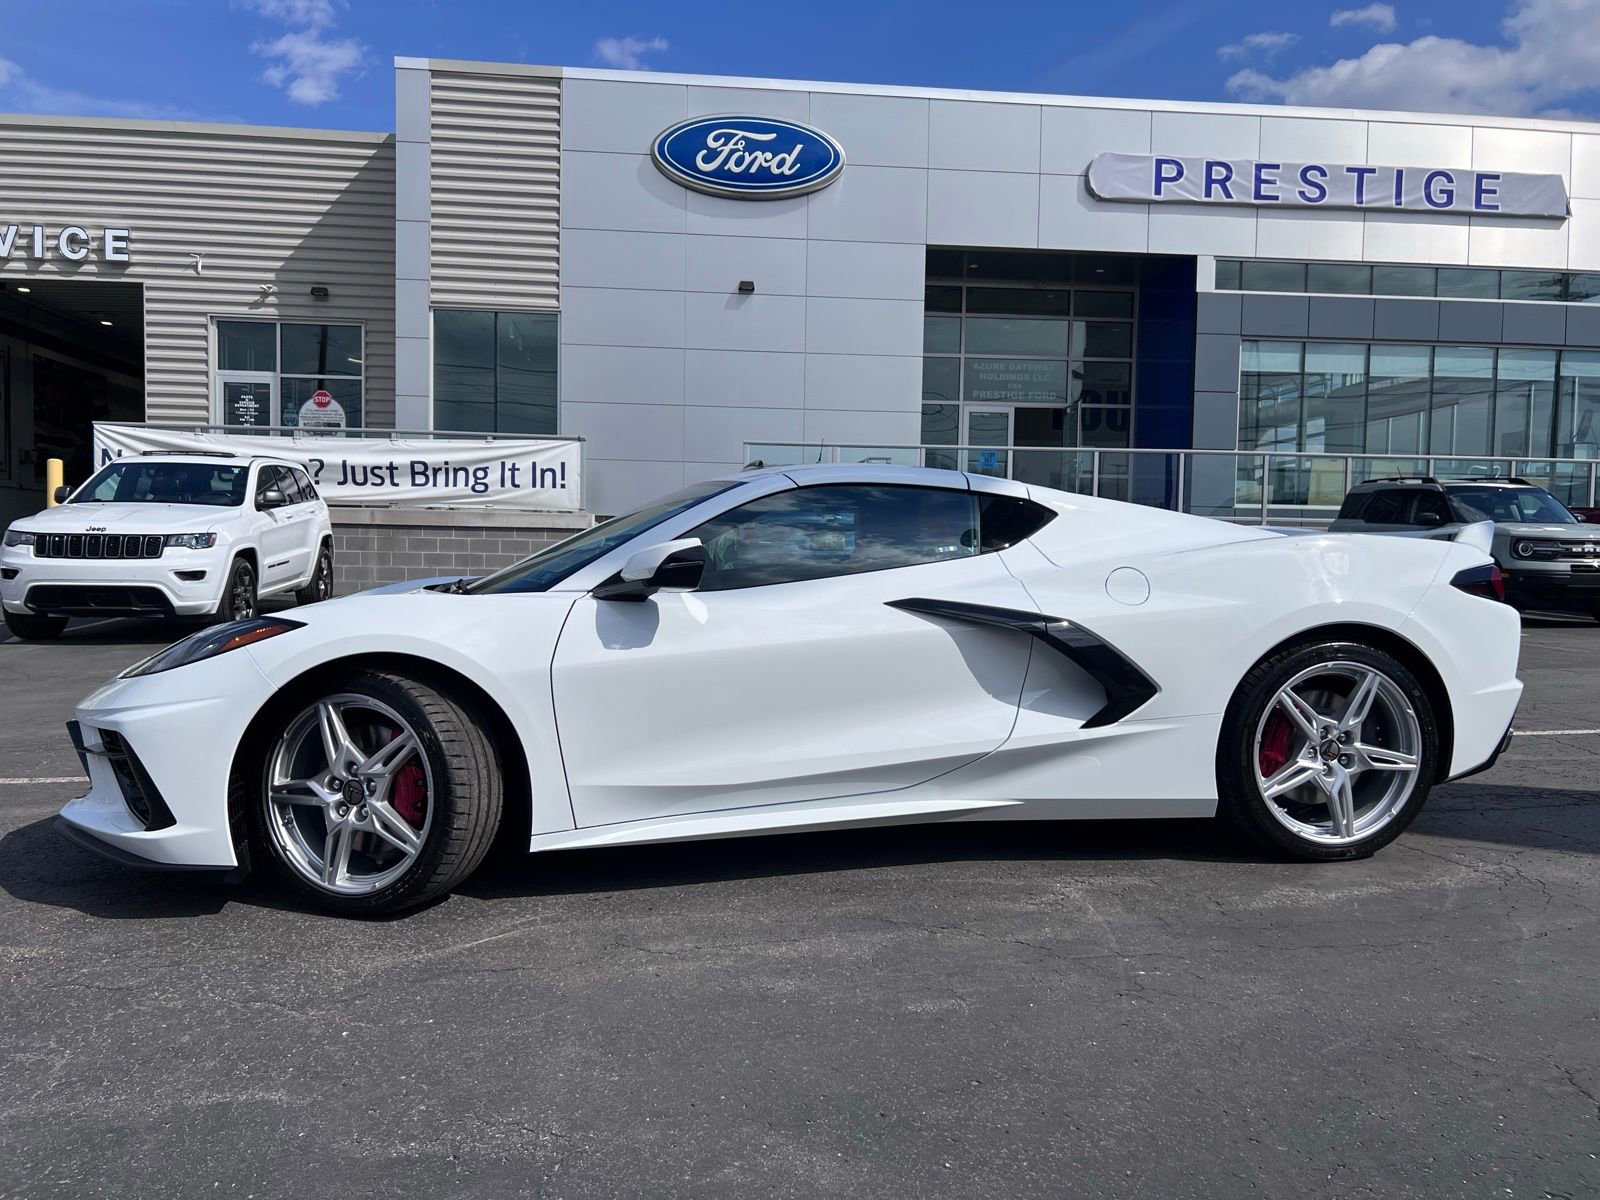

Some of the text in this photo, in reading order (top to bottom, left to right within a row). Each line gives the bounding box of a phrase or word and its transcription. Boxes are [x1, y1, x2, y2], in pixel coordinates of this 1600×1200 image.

[695, 128, 804, 176] Ford
[1152, 157, 1502, 211] PRESTIGE
[0, 224, 130, 261] VICE
[972, 362, 1006, 370] AZURE
[979, 373, 1051, 382] HOLDINGS LLC
[972, 390, 1057, 400] PRESTIGE FORD
[337, 459, 400, 487] Just
[409, 460, 490, 494] Bring
[500, 461, 521, 488] It
[531, 461, 566, 489] In!
[85, 525, 107, 533] Jeep
